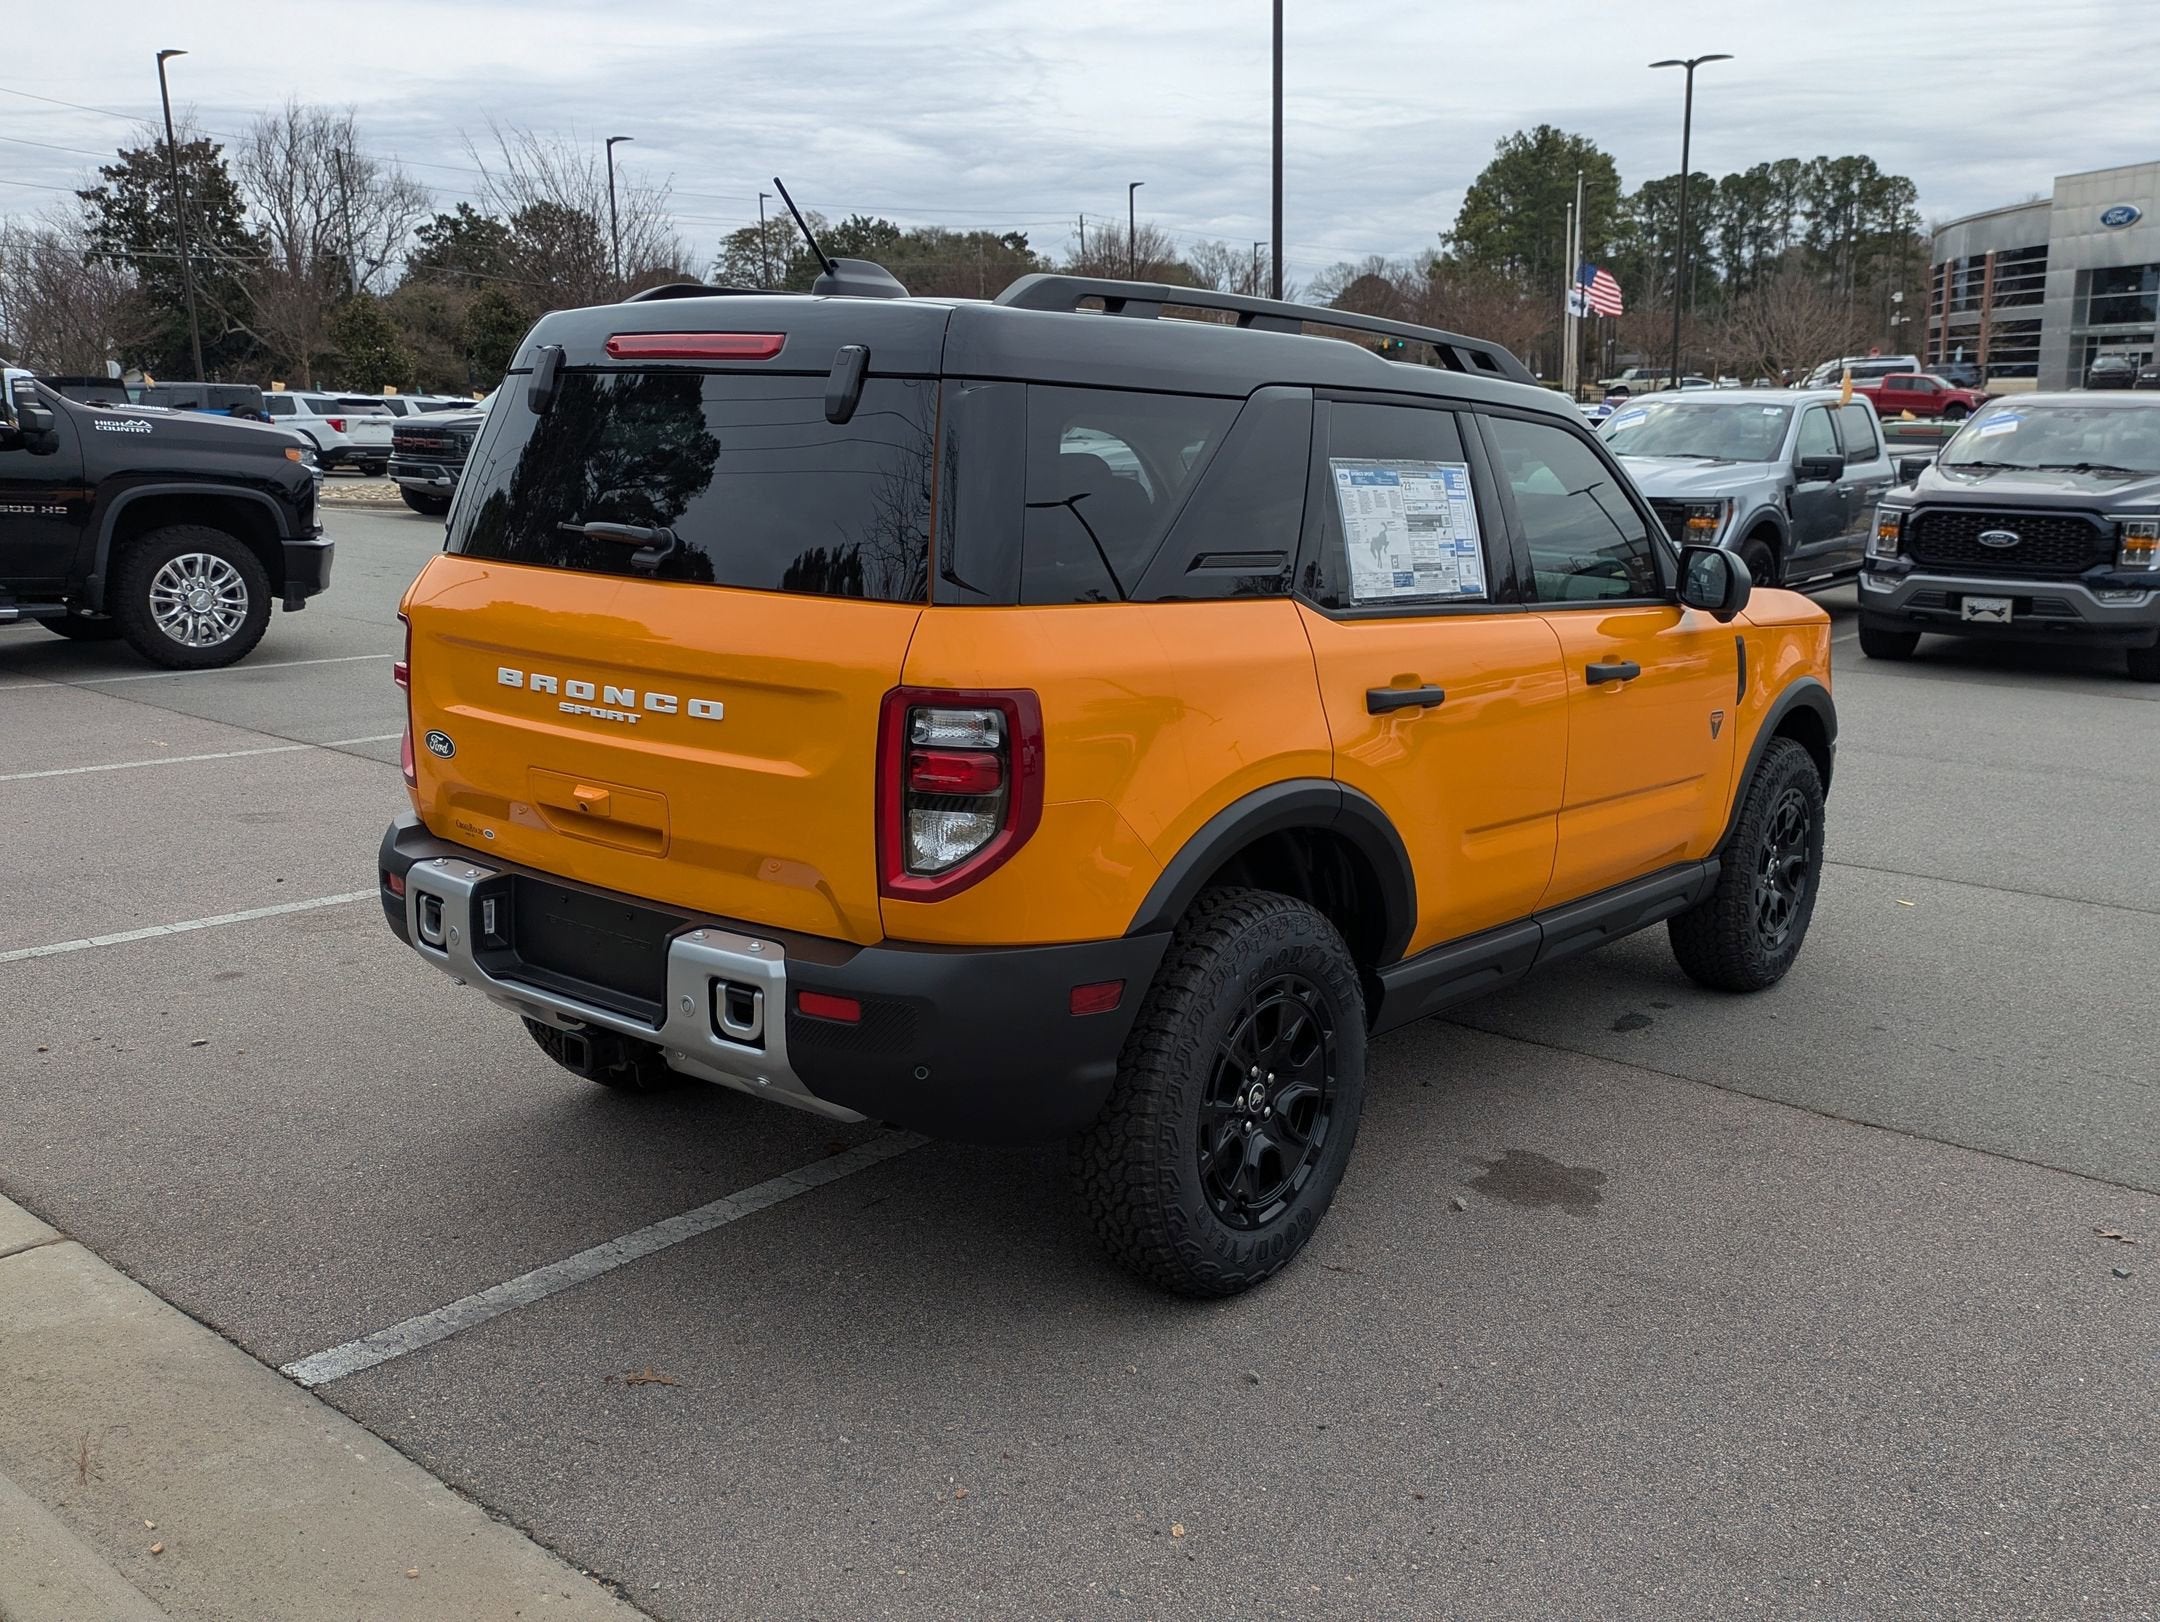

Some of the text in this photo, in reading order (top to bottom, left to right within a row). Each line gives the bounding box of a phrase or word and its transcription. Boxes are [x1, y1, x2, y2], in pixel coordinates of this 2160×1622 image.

[2105, 209, 2130, 225] Ford
[94, 419, 124, 427] HIGH
[95, 425, 153, 434] COUNTRY
[41, 505, 68, 514] HD
[497, 666, 724, 721] BRONCO
[558, 702, 641, 724] SPORT
